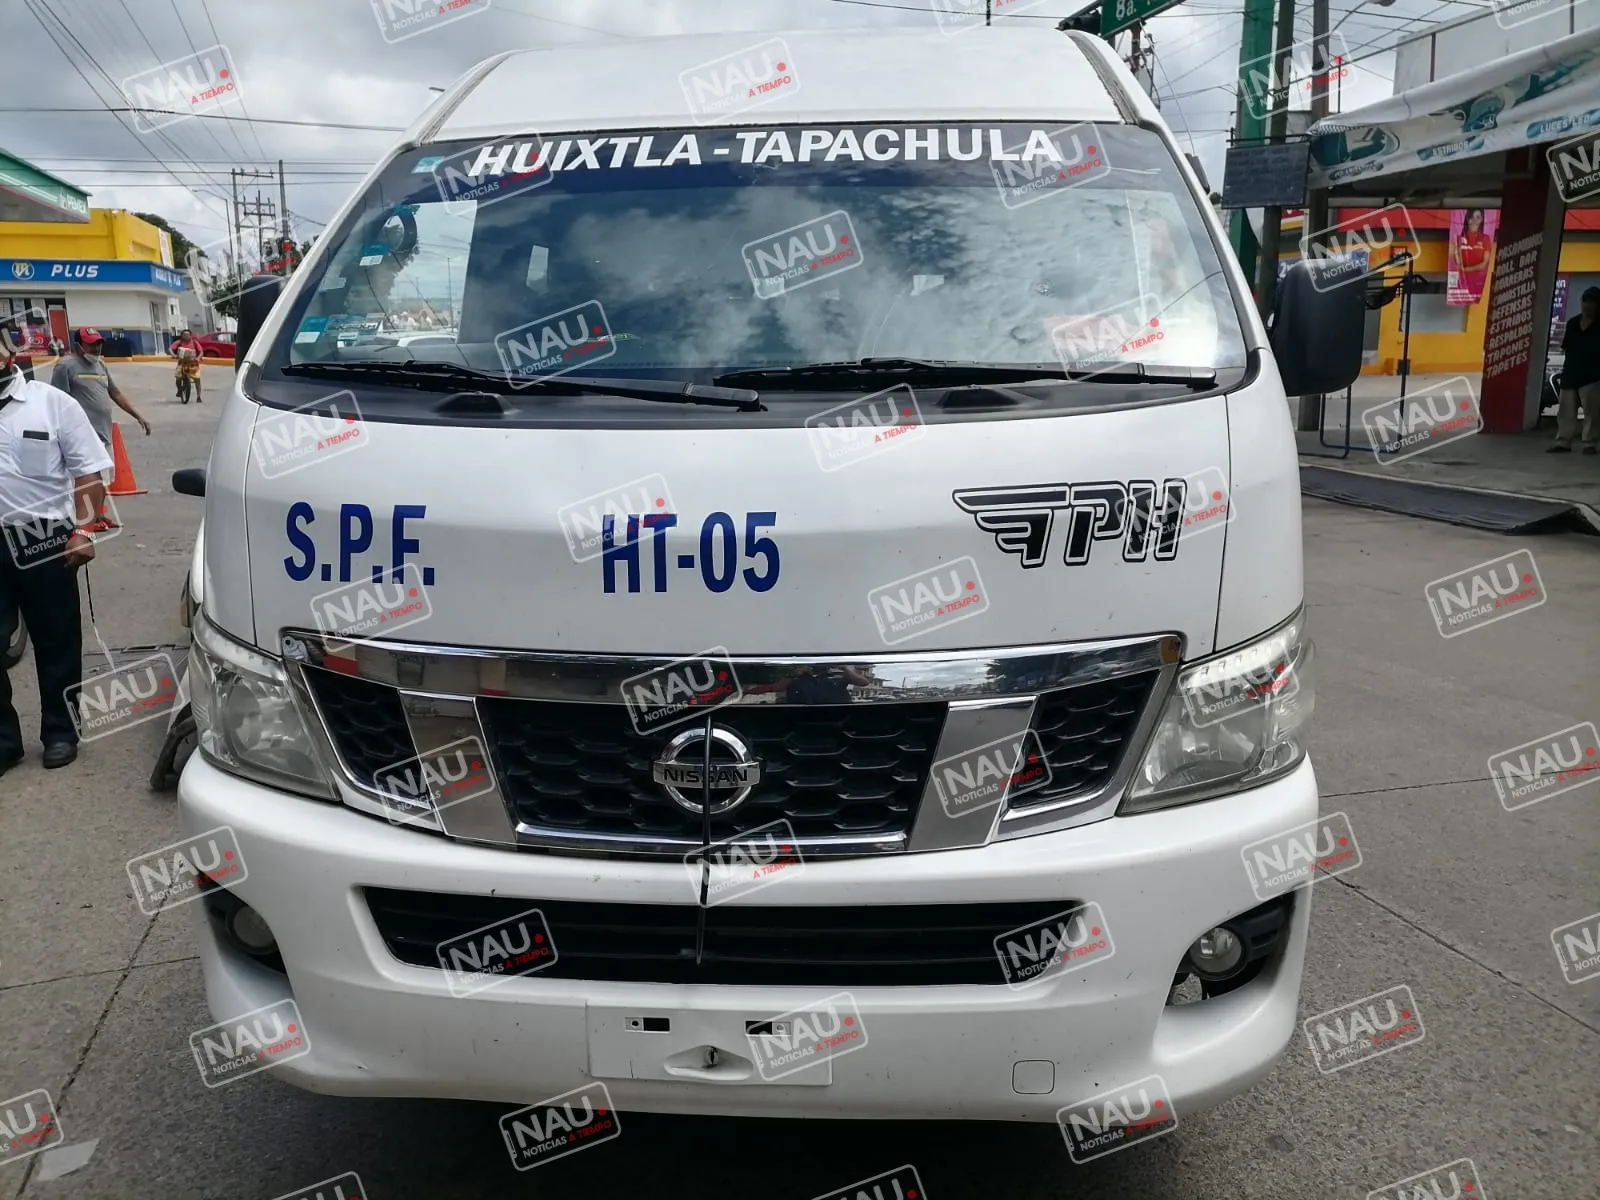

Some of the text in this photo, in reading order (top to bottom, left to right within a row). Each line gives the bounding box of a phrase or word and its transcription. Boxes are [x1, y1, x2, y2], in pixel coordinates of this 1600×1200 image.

[468, 133, 702, 177] HUIXTLA
[51, 263, 99, 279] PLUS
[1486, 351, 1528, 380] TAPETES
[1487, 337, 1531, 365] TAPONES
[283, 501, 435, 586] S.P.F.
[602, 502, 780, 593] HT-05
